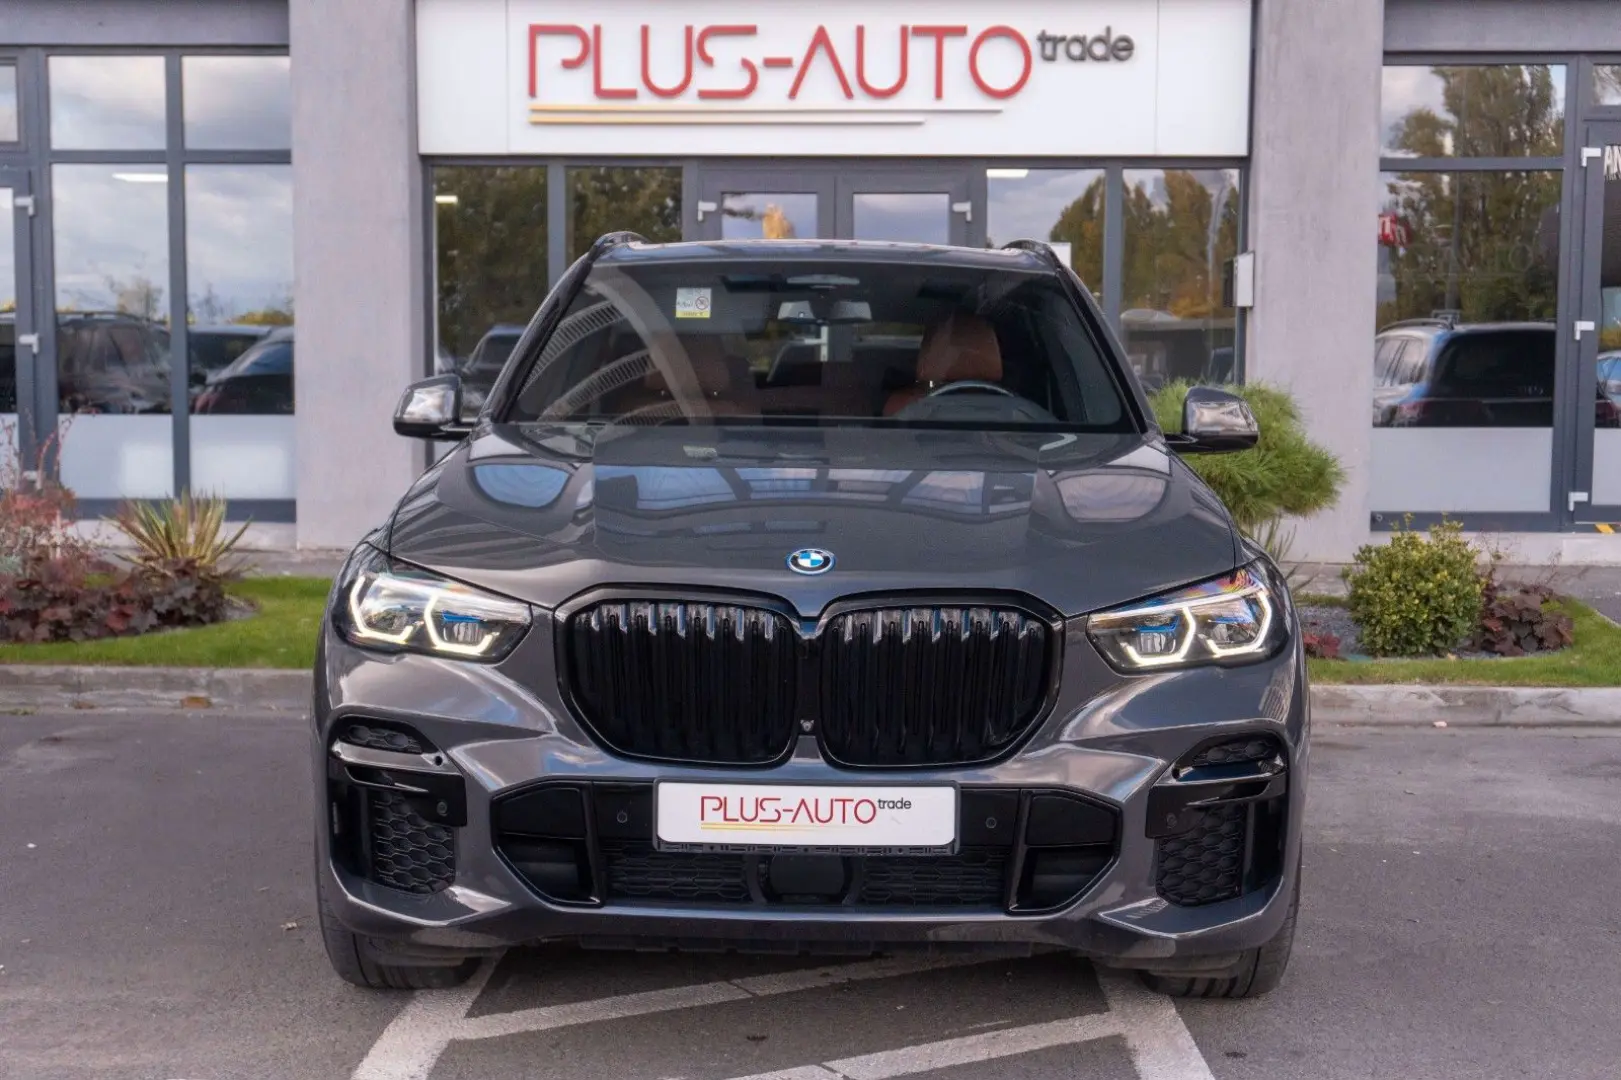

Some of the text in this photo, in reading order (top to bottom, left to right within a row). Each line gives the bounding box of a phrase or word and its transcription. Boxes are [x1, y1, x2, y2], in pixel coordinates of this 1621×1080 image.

[528, 24, 1135, 99] PLUS-AUTO trade
[700, 796, 912, 824] PLUS-AUTO trade
